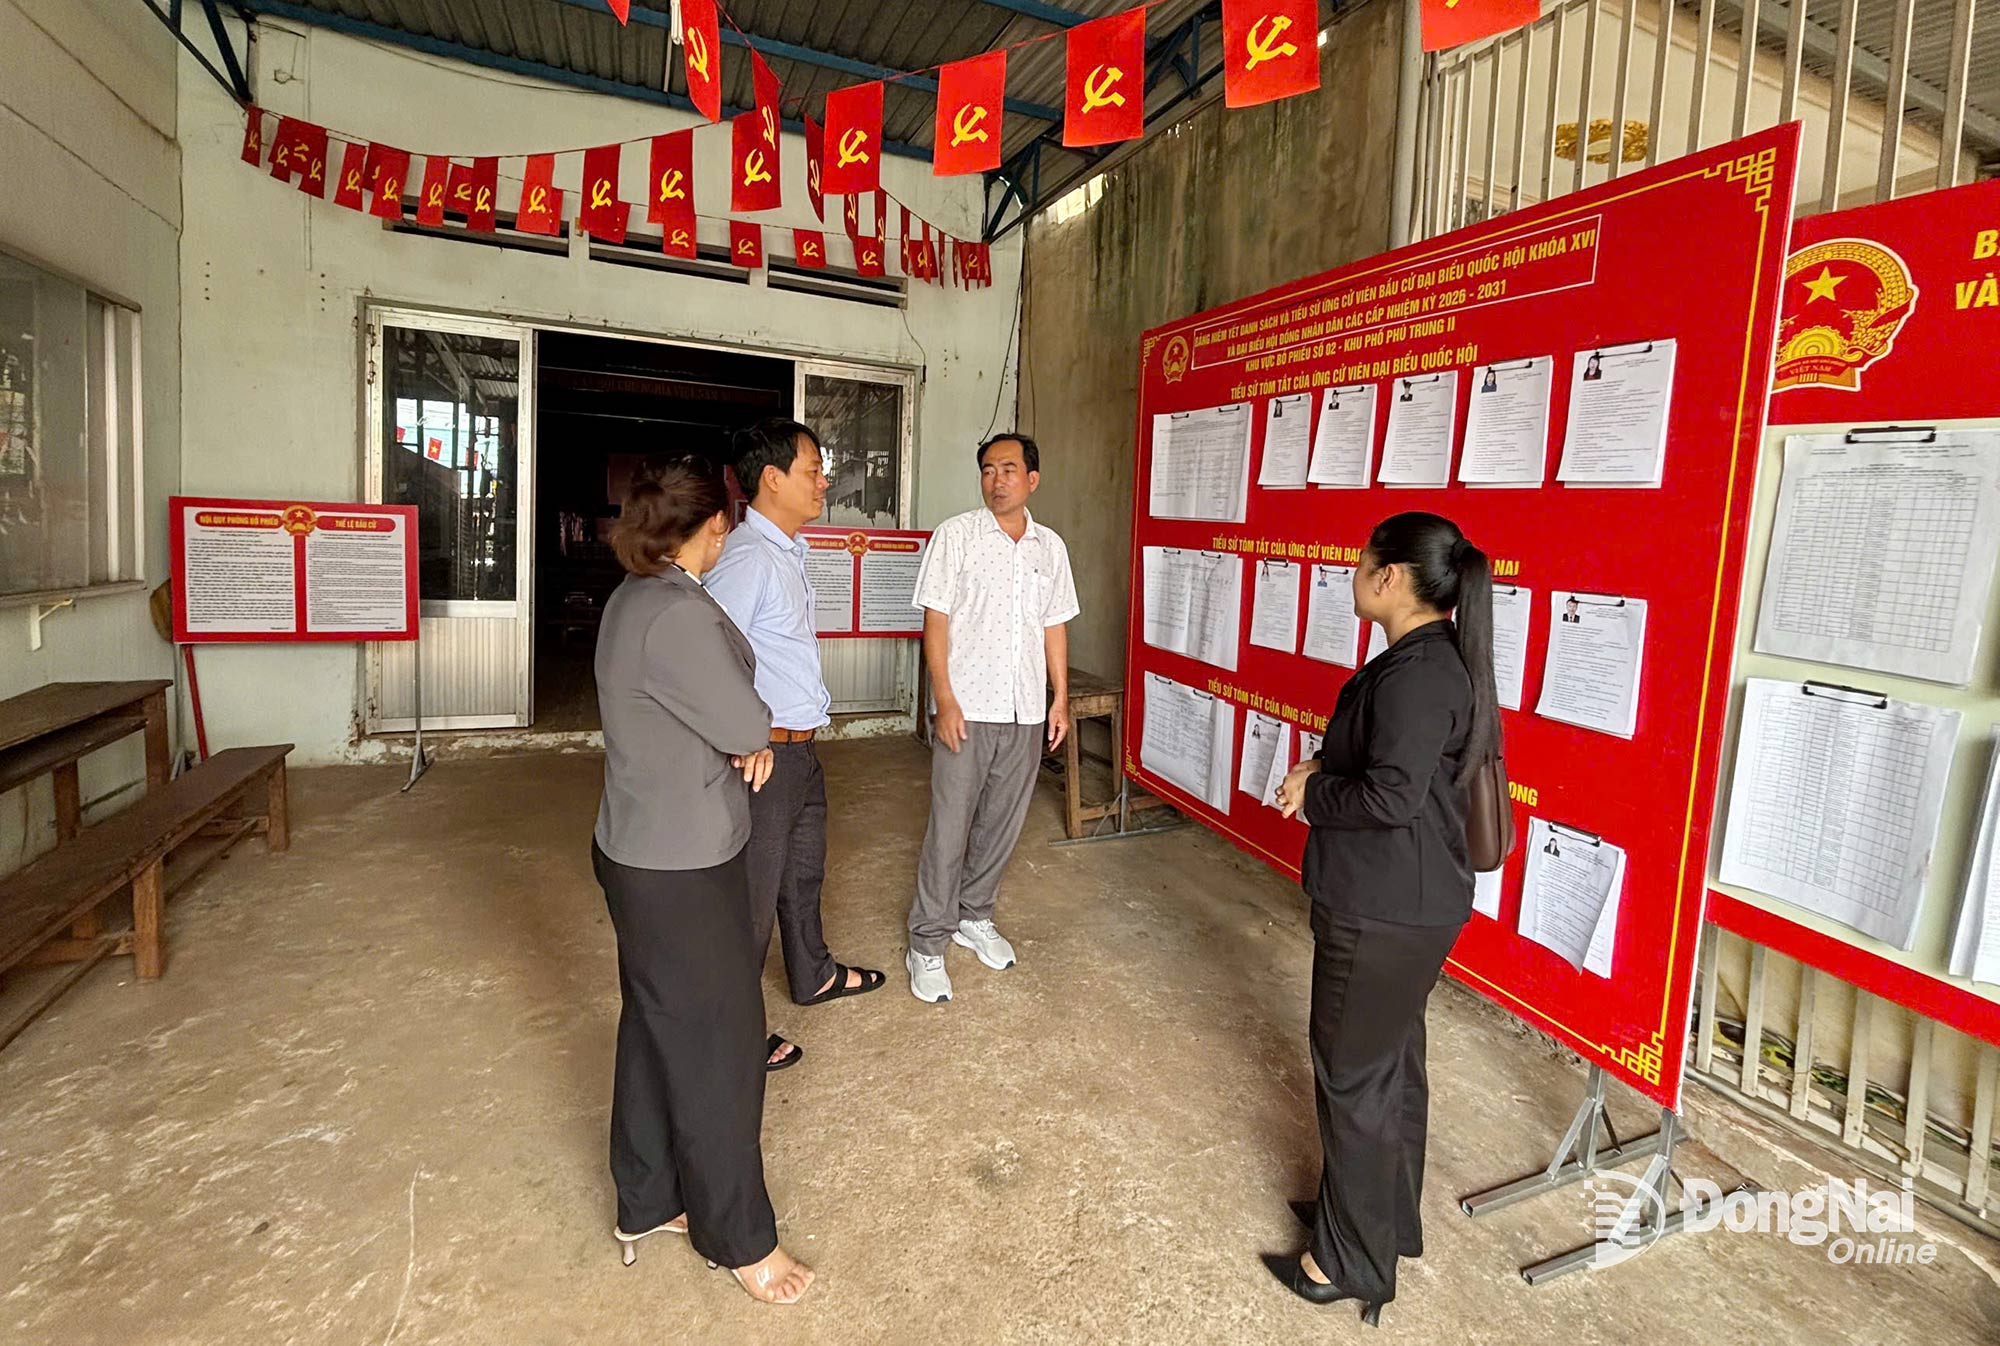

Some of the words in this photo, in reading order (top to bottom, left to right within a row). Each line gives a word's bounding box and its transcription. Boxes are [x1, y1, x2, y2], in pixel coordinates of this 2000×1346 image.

[1973, 229, 2000, 260] B
[1228, 323, 1240, 339] YẾT
[1240, 321, 1259, 336] DANH
[1259, 315, 1279, 332] SÁCH
[1279, 311, 1290, 328] VÀ
[1291, 303, 1308, 323] TIỂU
[1309, 298, 1322, 317] SỬ
[1321, 296, 1340, 313] ỨNG
[1341, 288, 1356, 308] CỬ
[1356, 285, 1377, 305] VIÊN
[1401, 271, 1417, 293] CỬ
[1417, 270, 1436, 291] ĐẠI
[1437, 258, 1465, 284] BIỂU
[1466, 250, 1501, 278] QUỐC
[1502, 245, 1526, 269] HỘI
[1528, 235, 1567, 262] KHÓA
[1569, 228, 1597, 252] XVI
[1955, 272, 2000, 310] VÀ
[1227, 343, 1236, 358] VÀ
[1248, 334, 1265, 353] BIỂU
[1265, 332, 1278, 351] HỘI
[1301, 321, 1324, 340] NHÂN
[1325, 315, 1343, 333] DÂN
[1345, 311, 1364, 329] CÁC
[1365, 303, 1385, 325] CẤP
[1386, 298, 1420, 320] NHIỆM
[1438, 288, 1467, 308] 2026
[1477, 279, 1507, 300] 2031
[1245, 357, 1259, 373] KHU
[1260, 354, 1276, 372] VỰC
[1276, 348, 1287, 365] BỎ
[1288, 344, 1311, 364] PHIẾU
[1312, 338, 1325, 359] SỐ
[1325, 341, 1337, 357] 02
[1343, 335, 1363, 353] KHU
[1364, 326, 1385, 348] PHỐ
[1385, 322, 1408, 344] PHÚ
[1408, 318, 1445, 340] TRUNG
[1447, 315, 1456, 333] II
[1231, 379, 1247, 401] TIỂU
[1247, 377, 1260, 397] SỬ
[1260, 376, 1277, 396] TÓM
[1277, 374, 1292, 393] TẮT
[1293, 370, 1310, 390] CỦA
[1312, 368, 1331, 387] ỨNG
[1332, 362, 1347, 384] CỬ
[1348, 361, 1371, 381] VIÊN
[1372, 359, 1391, 380] ĐẠI
[1392, 349, 1419, 374] BIỂU
[1420, 343, 1454, 370] QUỐC
[1455, 341, 1479, 367] HỘI
[1212, 533, 1227, 550] TIỂU
[1228, 535, 1239, 551] SỬ
[1239, 535, 1255, 551] TÓM
[1256, 536, 1269, 554] TẮT
[1270, 538, 1287, 556] CỦA
[1288, 541, 1306, 558] ỨNG
[1307, 541, 1321, 559] CỬ
[1321, 543, 1343, 561] VIÊN
[1493, 559, 1520, 576] NAI
[1207, 677, 1222, 695] TIỂU
[1222, 682, 1234, 698] SỬ
[1233, 687, 1249, 705] TÓM
[1250, 690, 1264, 709] TẮT
[1264, 696, 1281, 716] CỦA
[1281, 703, 1299, 722] ỨNG
[1300, 708, 1314, 726] CỬ
[1313, 714, 1329, 732] VIÊ
